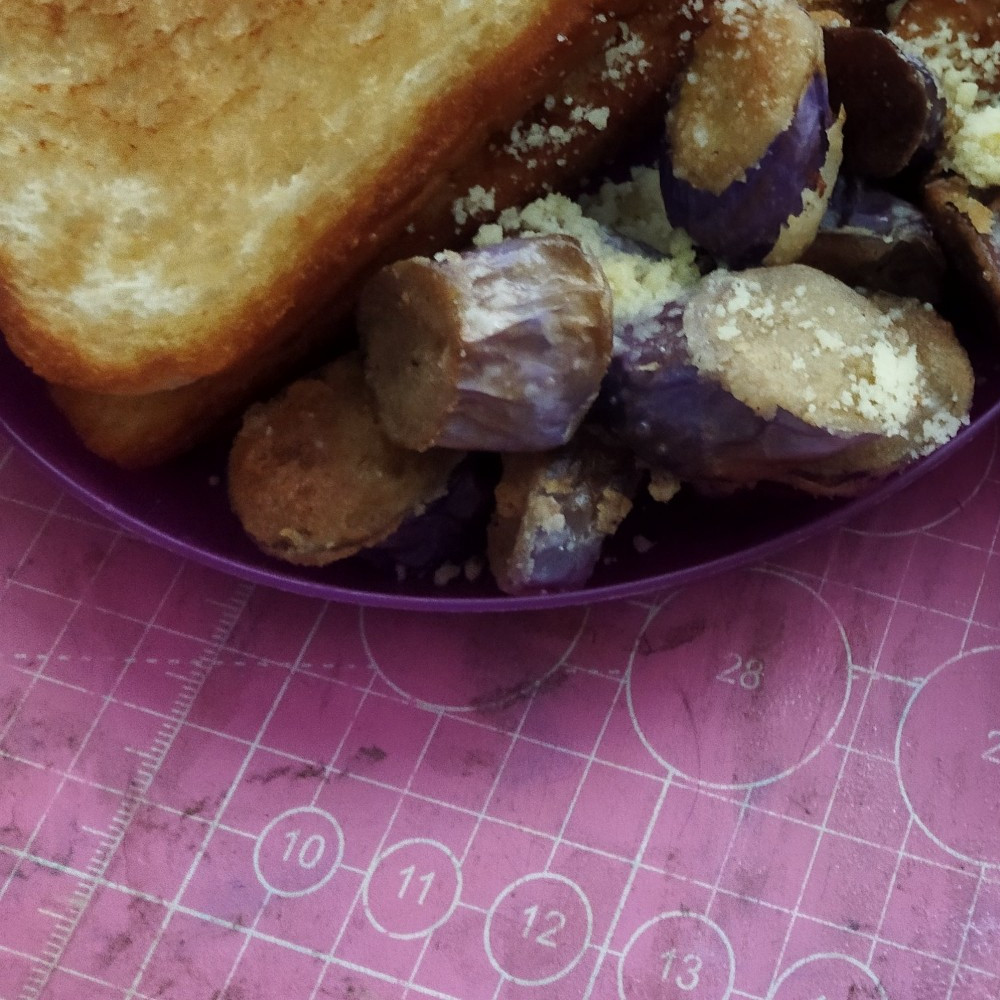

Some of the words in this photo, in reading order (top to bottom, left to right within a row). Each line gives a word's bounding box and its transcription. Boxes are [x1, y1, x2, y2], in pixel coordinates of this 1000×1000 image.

[716, 653, 764, 690] 28
[284, 829, 326, 870] 10
[397, 865, 437, 905] 11
[523, 905, 566, 946] 12
[660, 948, 703, 991] 13
